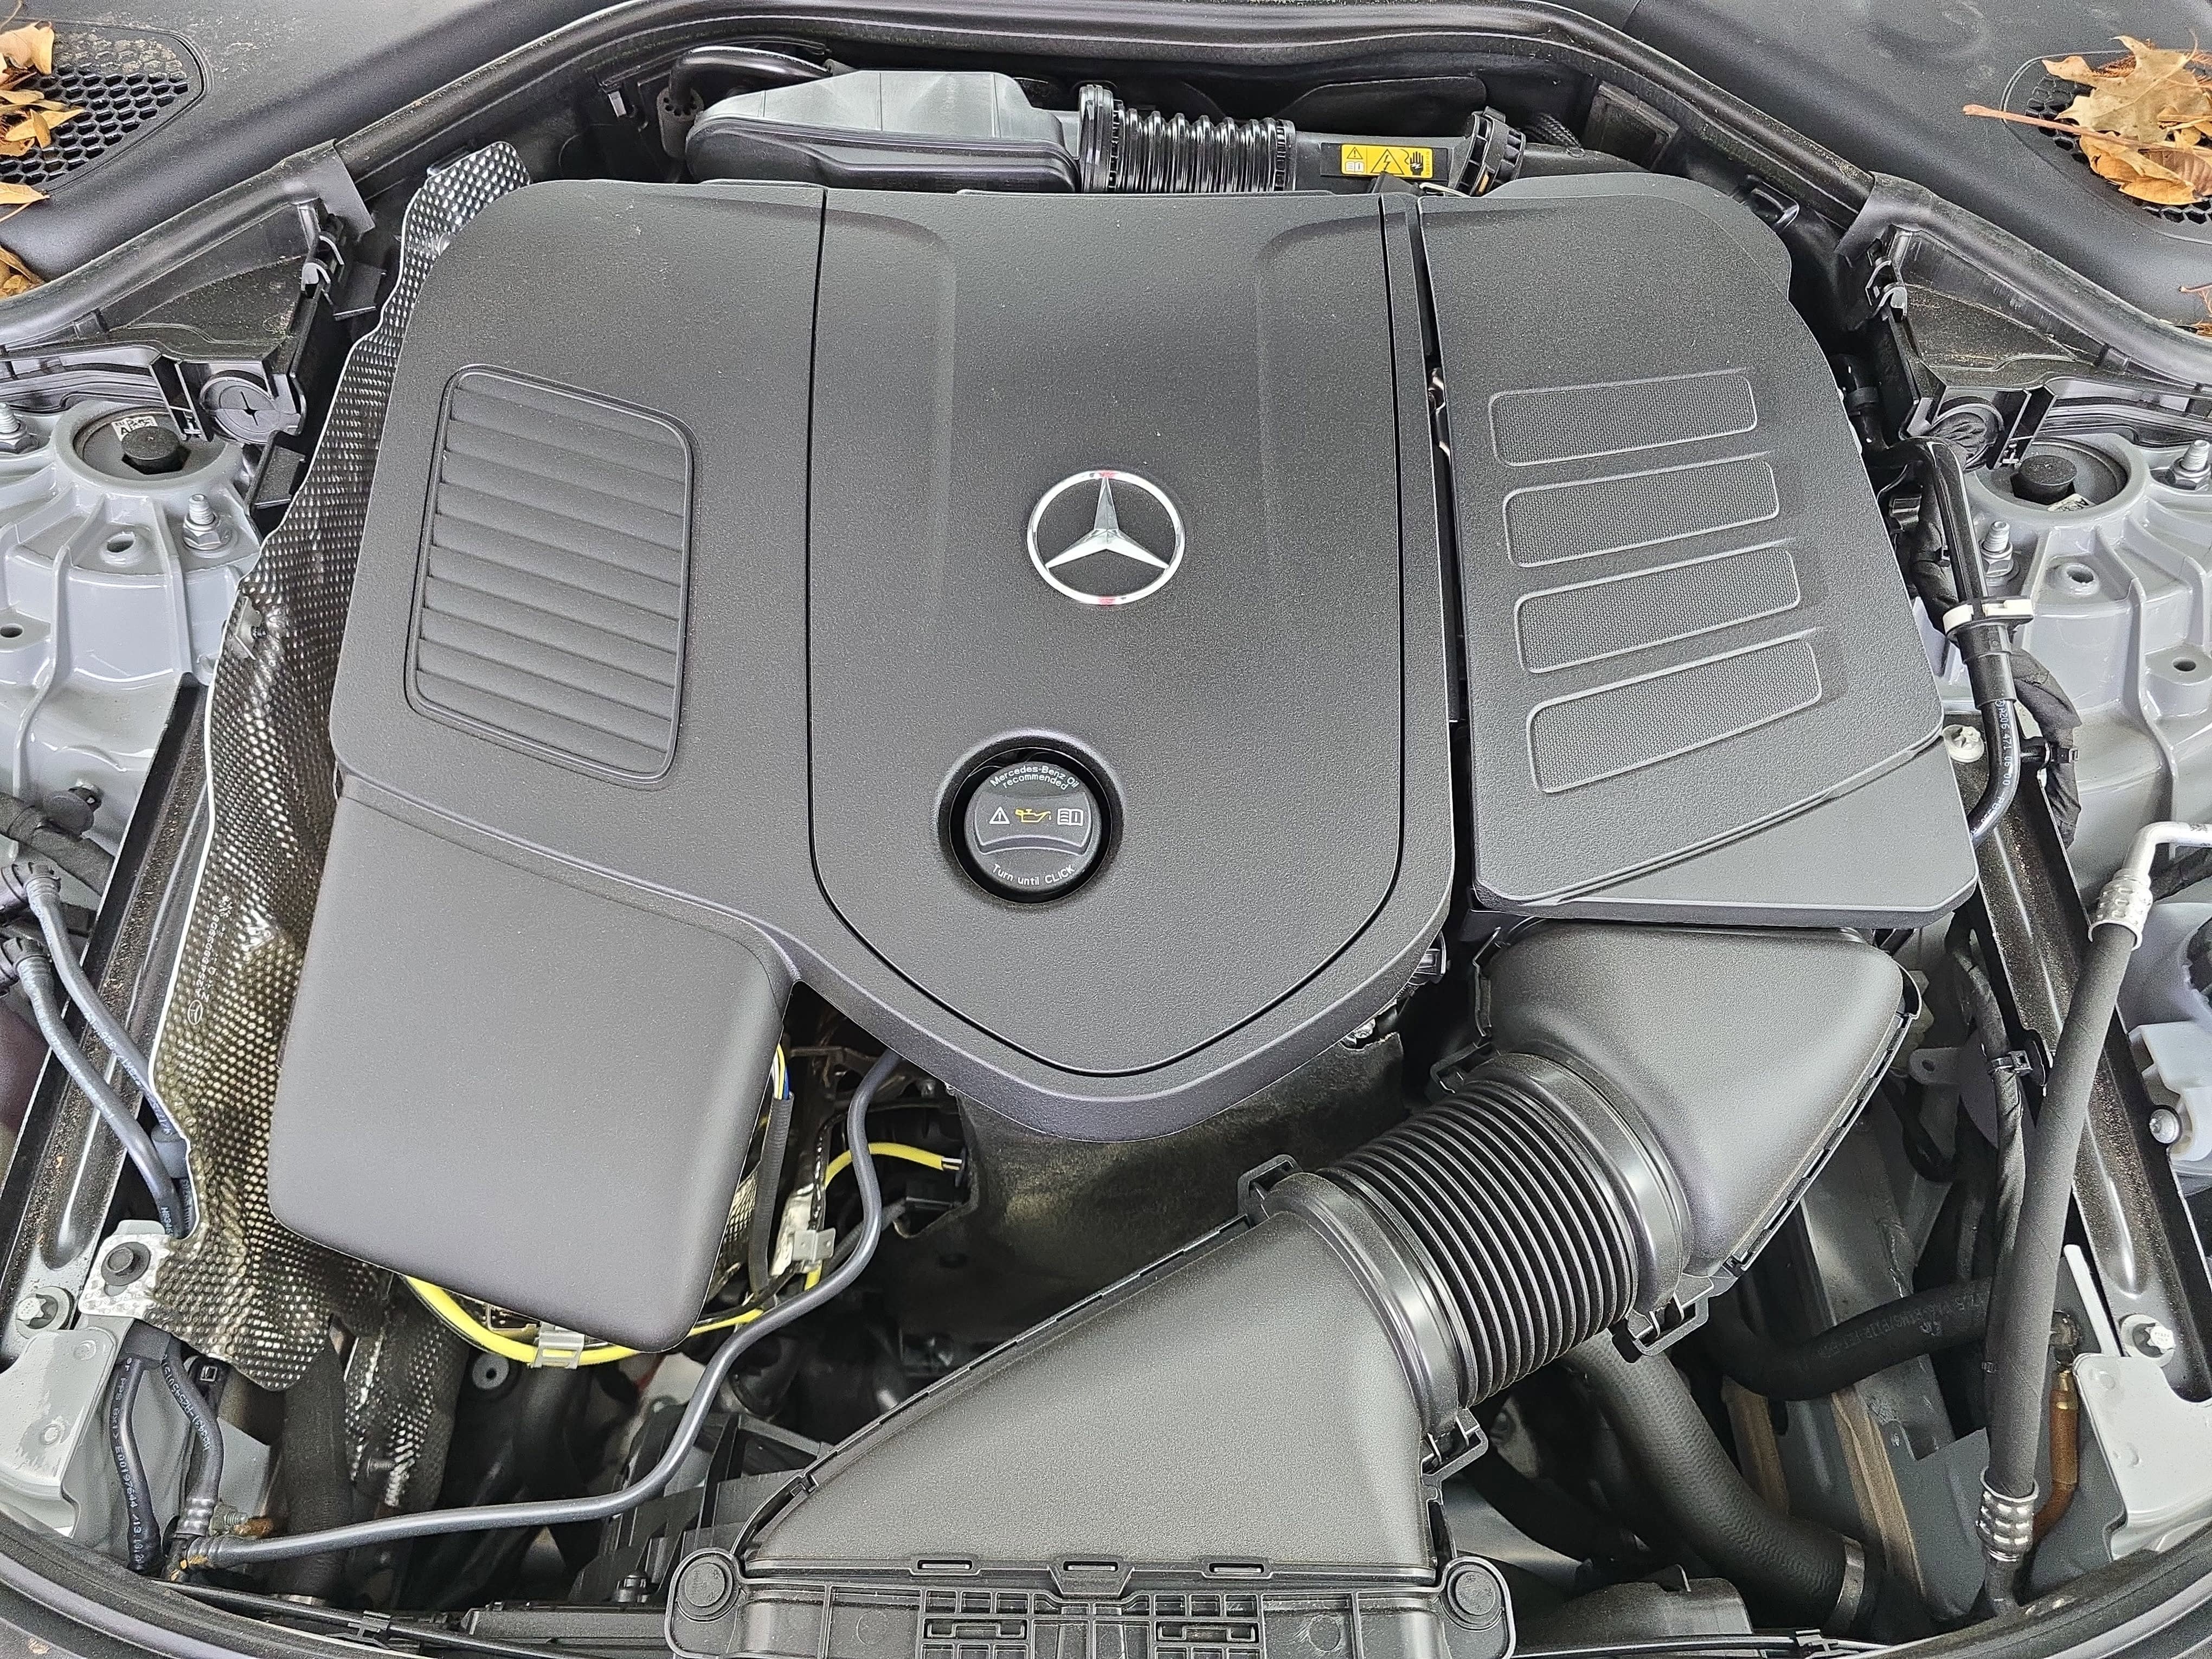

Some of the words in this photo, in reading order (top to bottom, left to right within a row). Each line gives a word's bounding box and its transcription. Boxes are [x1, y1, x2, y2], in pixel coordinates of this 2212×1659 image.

[2003, 734, 2012, 750] 471
[990, 766, 1066, 787] Mercedes-Benz
[1067, 778, 1079, 788] Oil
[1002, 773, 1069, 790] recommended
[2002, 774, 2012, 786] 00
[992, 863, 1014, 882] Turn
[1018, 877, 1040, 885] until
[1045, 864, 1076, 884] CLICK
